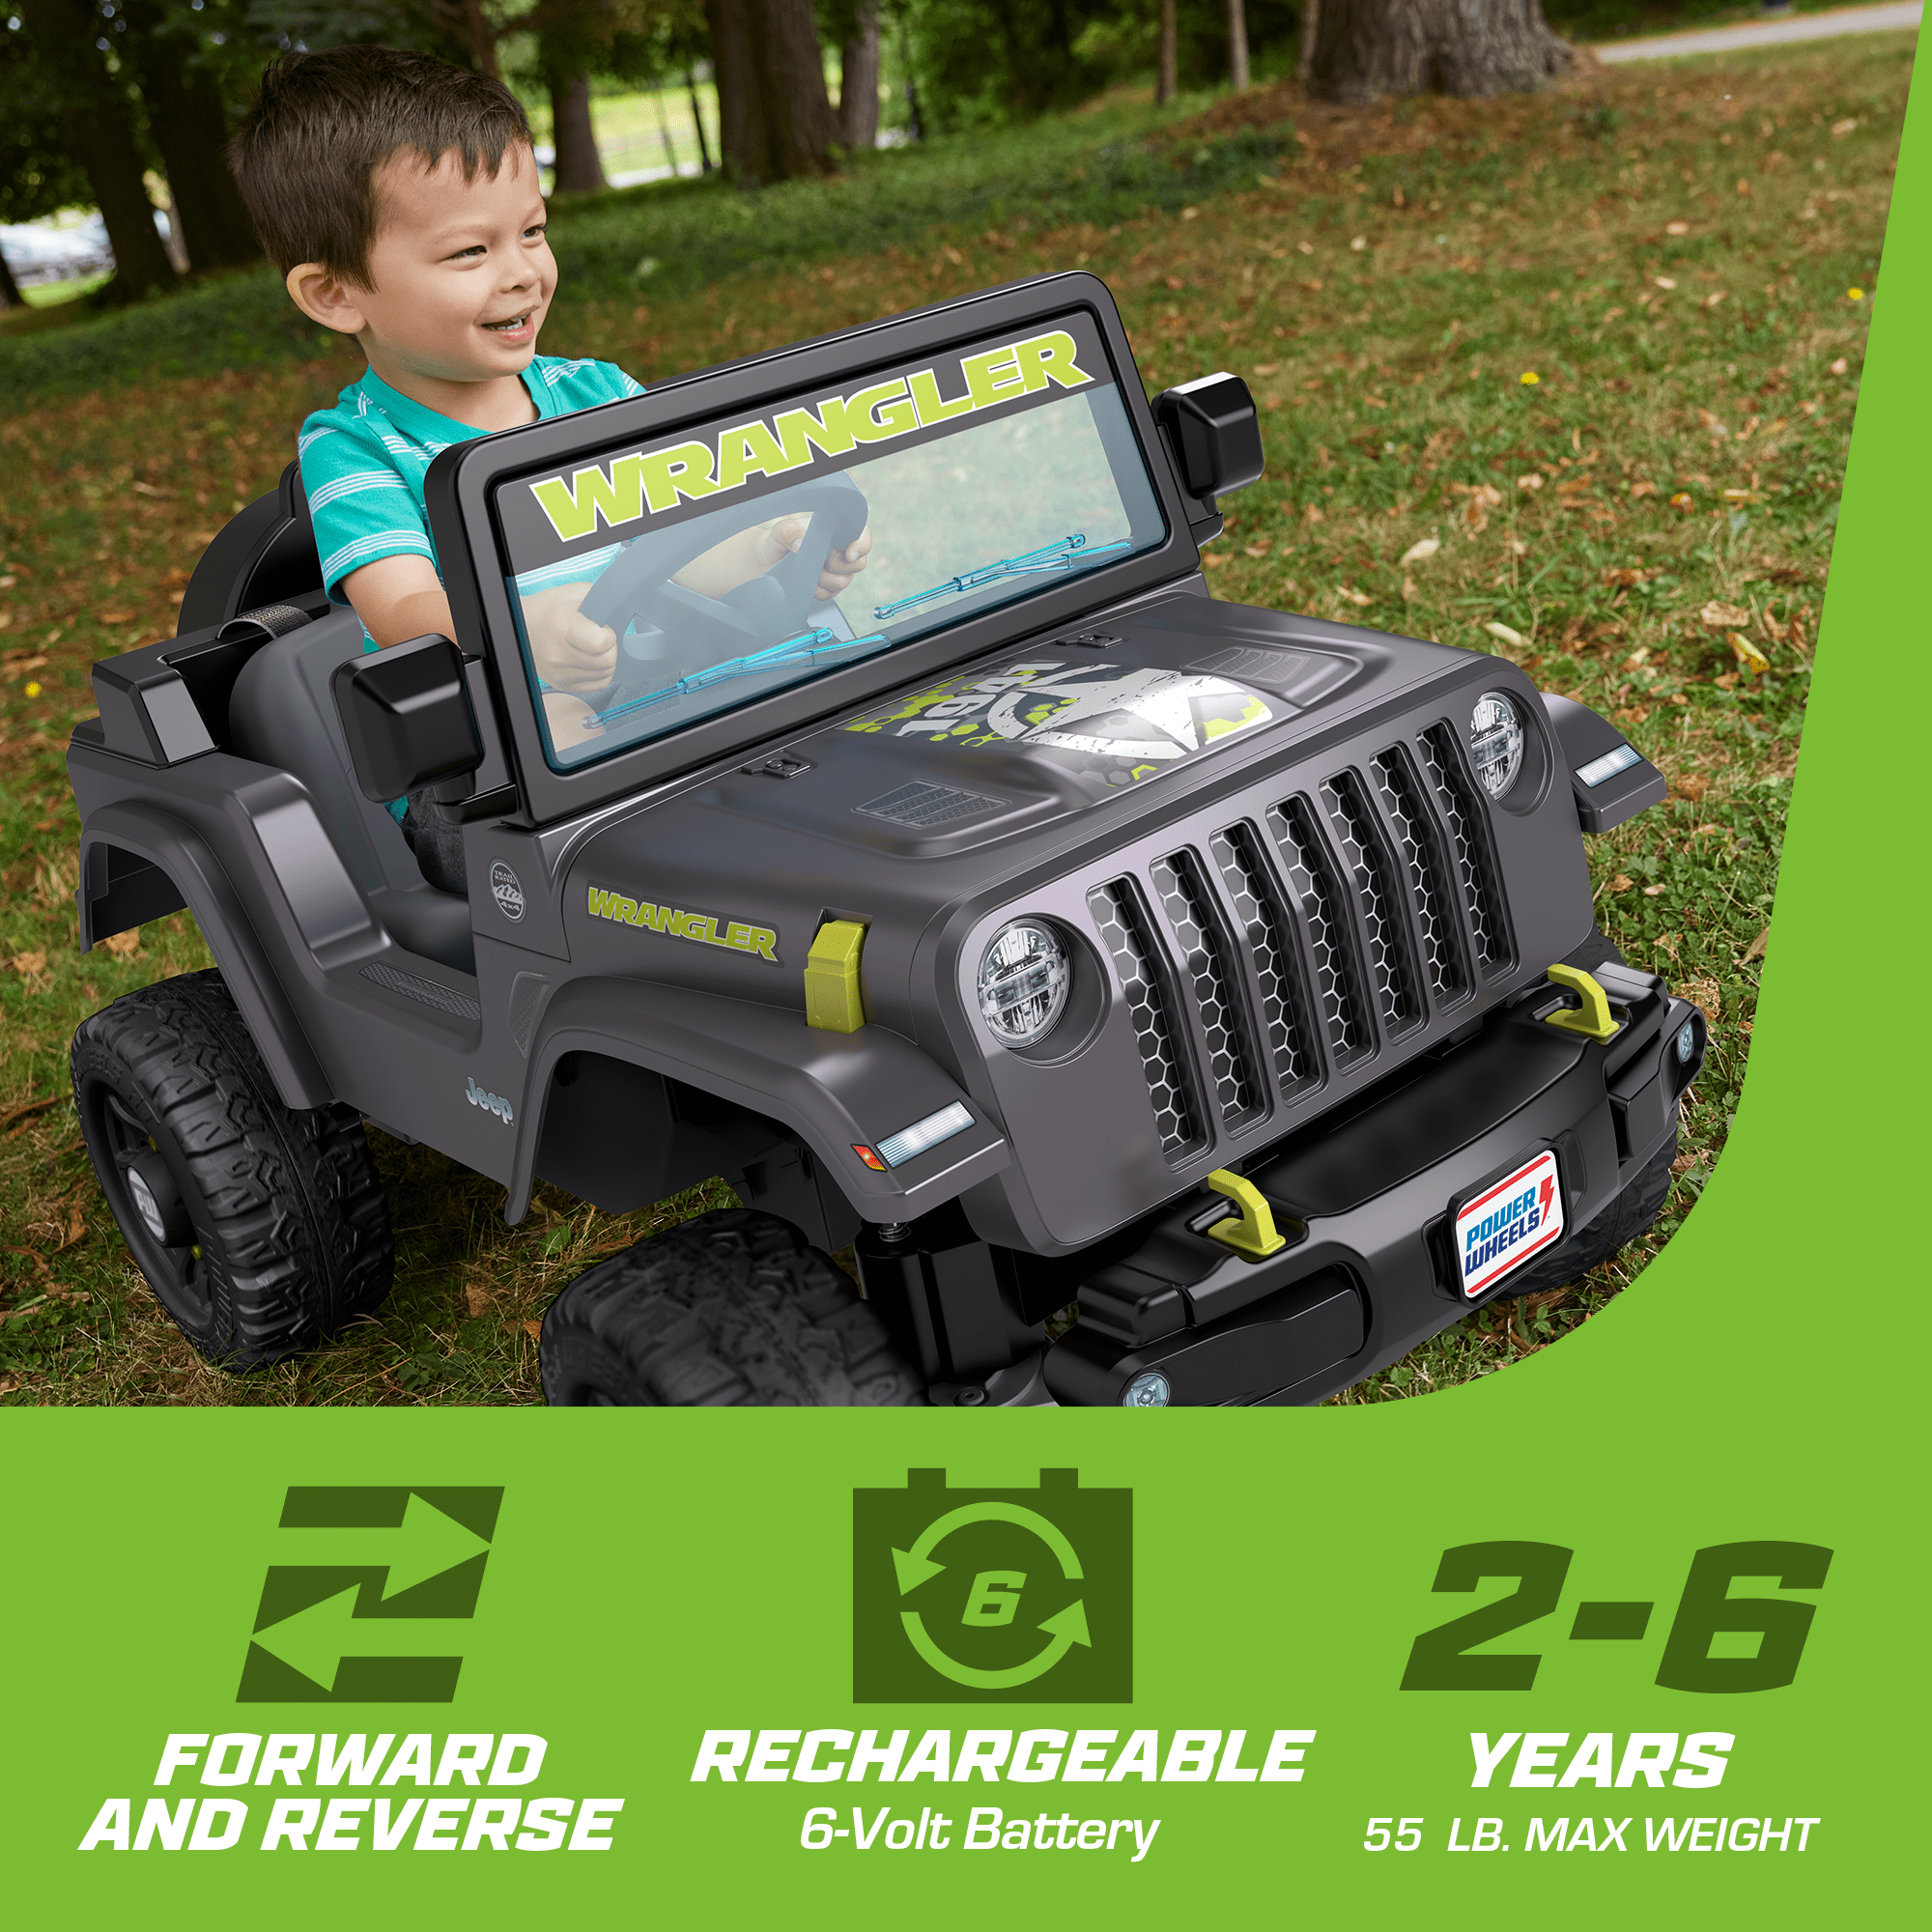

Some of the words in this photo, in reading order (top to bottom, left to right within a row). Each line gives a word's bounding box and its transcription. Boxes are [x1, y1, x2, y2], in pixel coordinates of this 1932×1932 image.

[528, 329, 1095, 542] WRANGLER
[494, 869, 513, 880] TRAIL
[494, 874, 516, 884] RATED
[587, 886, 779, 963] WRANGLER
[465, 1076, 513, 1124] Jeep
[1464, 1207, 1540, 1277] WHEELS
[1465, 1185, 1536, 1253] POWER
